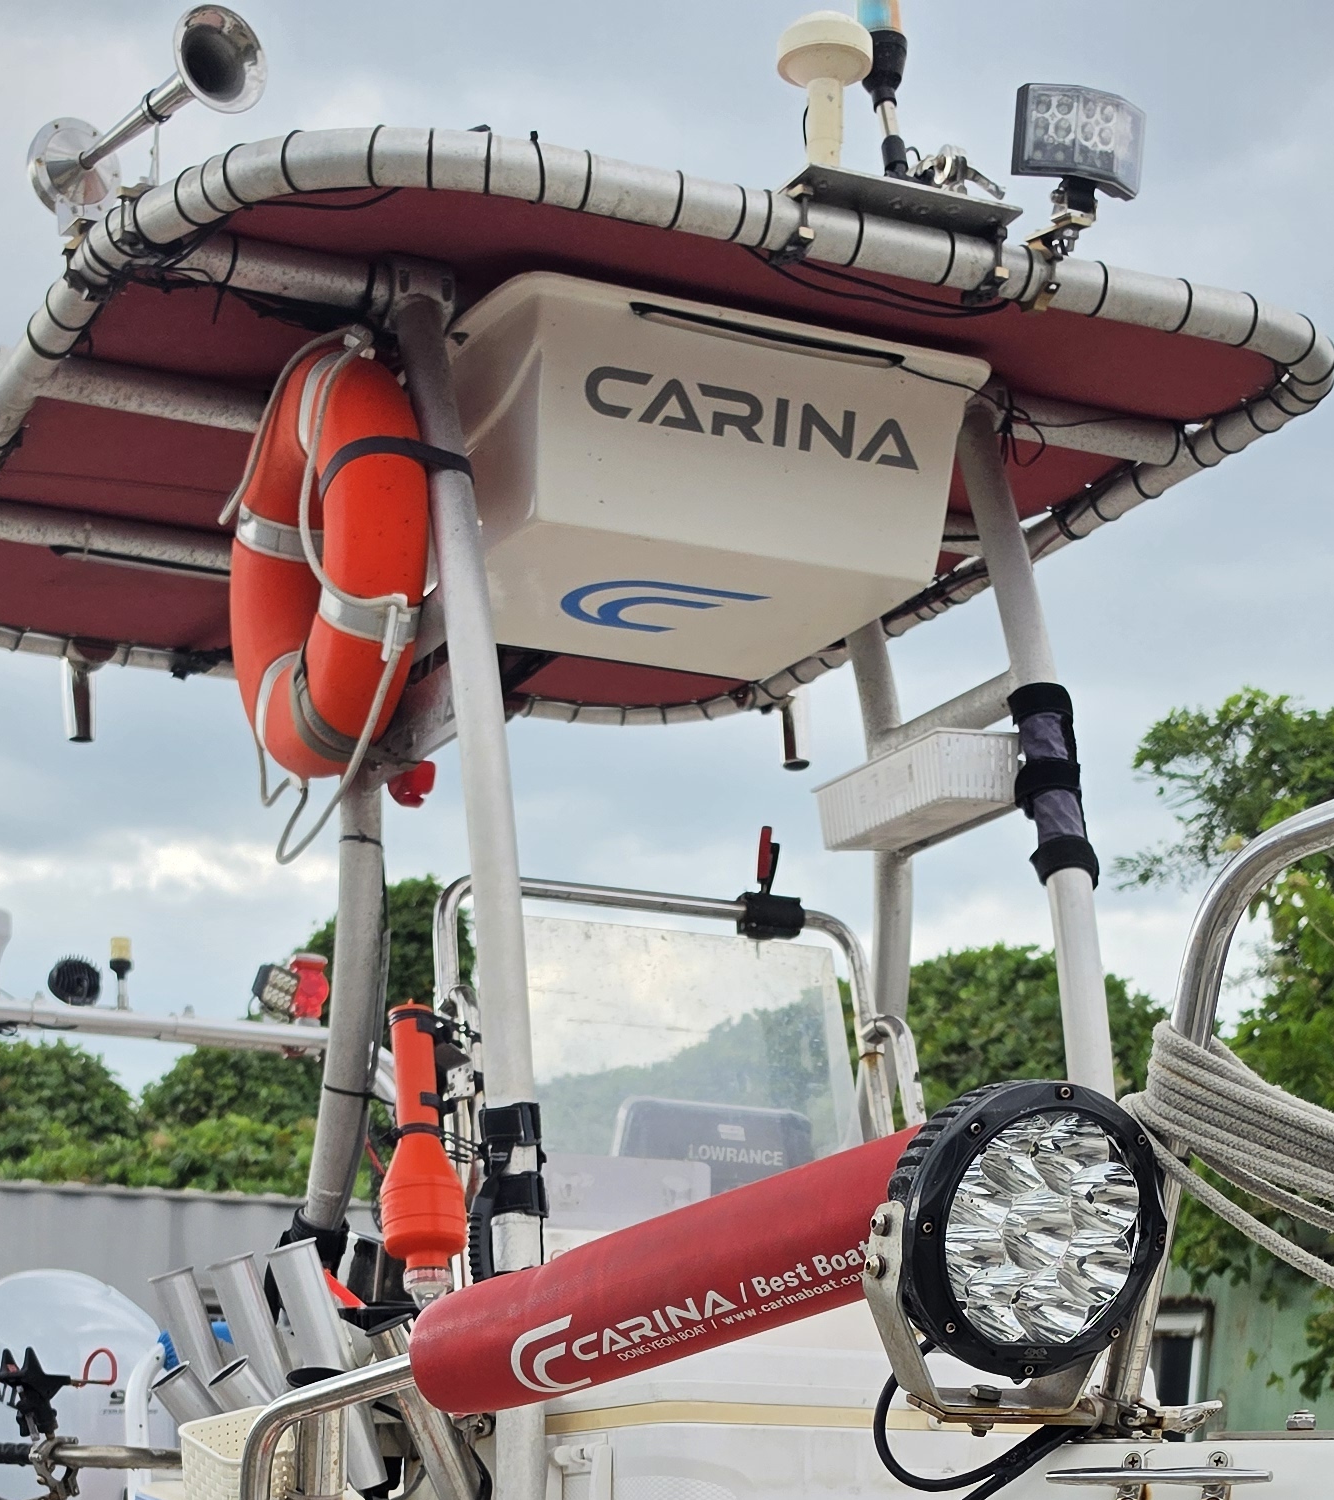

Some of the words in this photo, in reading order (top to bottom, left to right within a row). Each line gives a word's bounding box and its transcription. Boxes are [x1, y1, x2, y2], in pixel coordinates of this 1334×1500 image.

[585, 366, 919, 471] CARINA
[688, 1144, 784, 1167] LOWRANCE
[572, 1290, 738, 1361] CARINA
[751, 1262, 812, 1298] Best
[811, 1240, 869, 1277] Boat
[616, 1343, 653, 1362] DONG
[648, 1333, 682, 1354] YEON
[680, 1324, 708, 1343] BOAT
